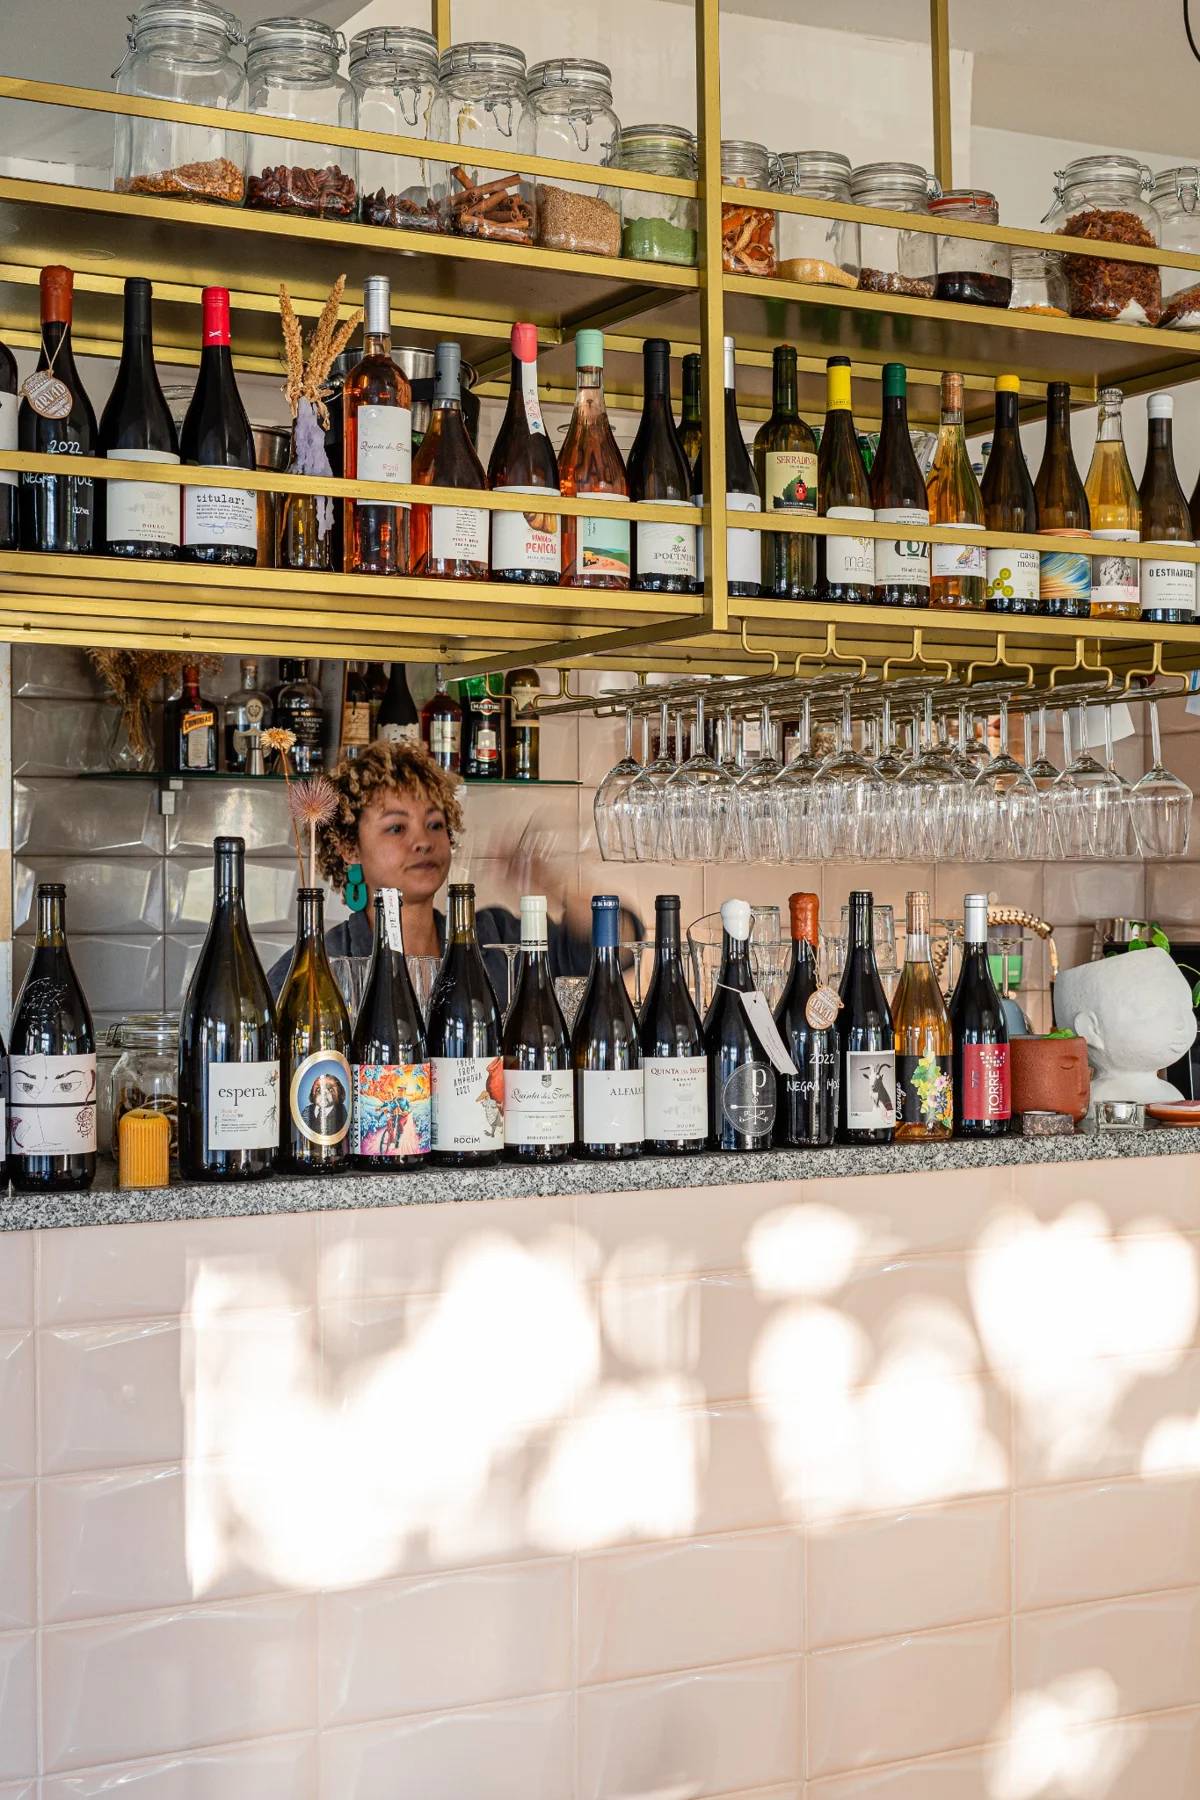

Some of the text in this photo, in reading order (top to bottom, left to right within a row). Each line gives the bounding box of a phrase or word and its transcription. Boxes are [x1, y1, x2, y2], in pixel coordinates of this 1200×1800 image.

[47, 440, 83, 455] 2022
[196, 494, 245, 505] titular:
[525, 542, 557, 554] PENICAS
[1019, 552, 1035, 560] casa
[1149, 568, 1154, 578] O
[808, 1053, 836, 1064] 2022
[458, 1065, 476, 1077] FROM
[650, 1067, 680, 1075] QUINTA
[453, 1072, 483, 1087] AMPHORA
[456, 1084, 471, 1096] 2021
[511, 1088, 540, 1103] Quinta
[786, 1080, 820, 1100] NEGRA
[988, 1070, 1000, 1115] TORRE
[218, 1087, 267, 1107] espera.
[896, 1082, 907, 1120] Orange
